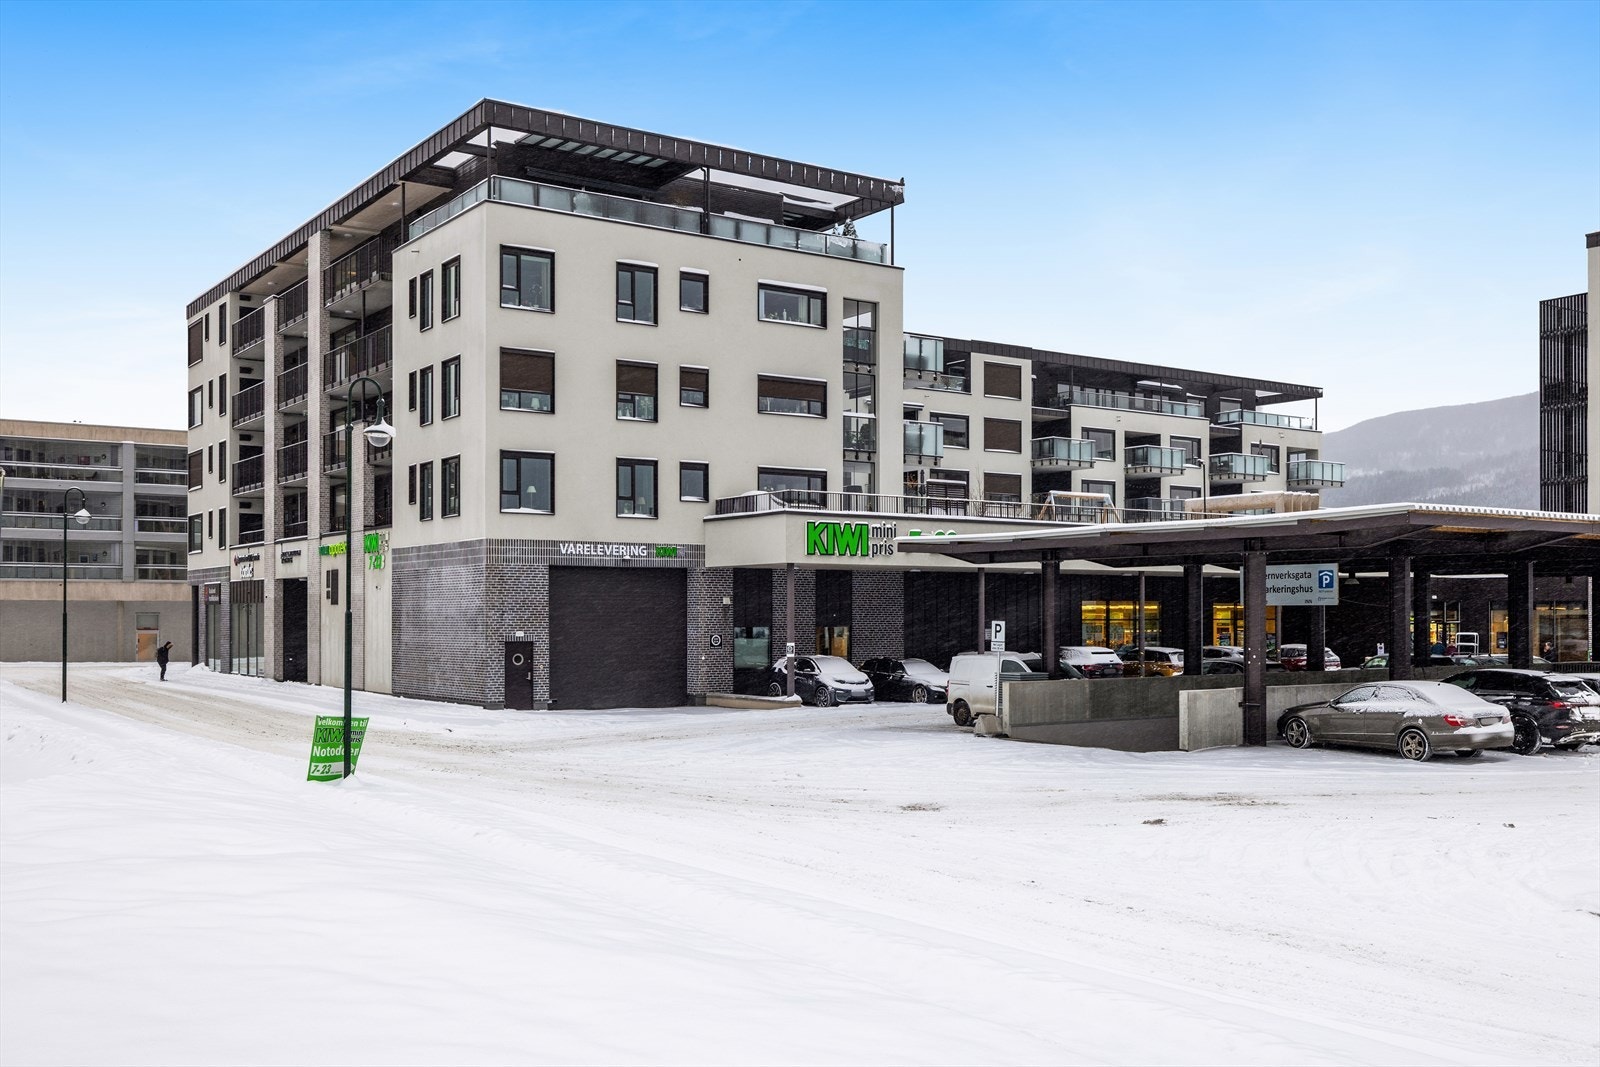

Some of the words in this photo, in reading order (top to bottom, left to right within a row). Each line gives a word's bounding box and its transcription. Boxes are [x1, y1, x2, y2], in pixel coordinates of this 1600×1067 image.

[871, 521, 897, 538] mini
[805, 520, 869, 557] KIWI
[559, 543, 647, 556] VARELEVERING
[871, 539, 894, 558] pris
[1266, 571, 1311, 580] ernverksgata
[1266, 585, 1313, 594] arkeringshus
[995, 624, 1002, 639] P
[317, 718, 358, 727] Velkomen
[359, 718, 367, 727] til
[315, 727, 344, 743] KIW
[313, 746, 359, 756] Notoden
[311, 764, 332, 775] 7-23
